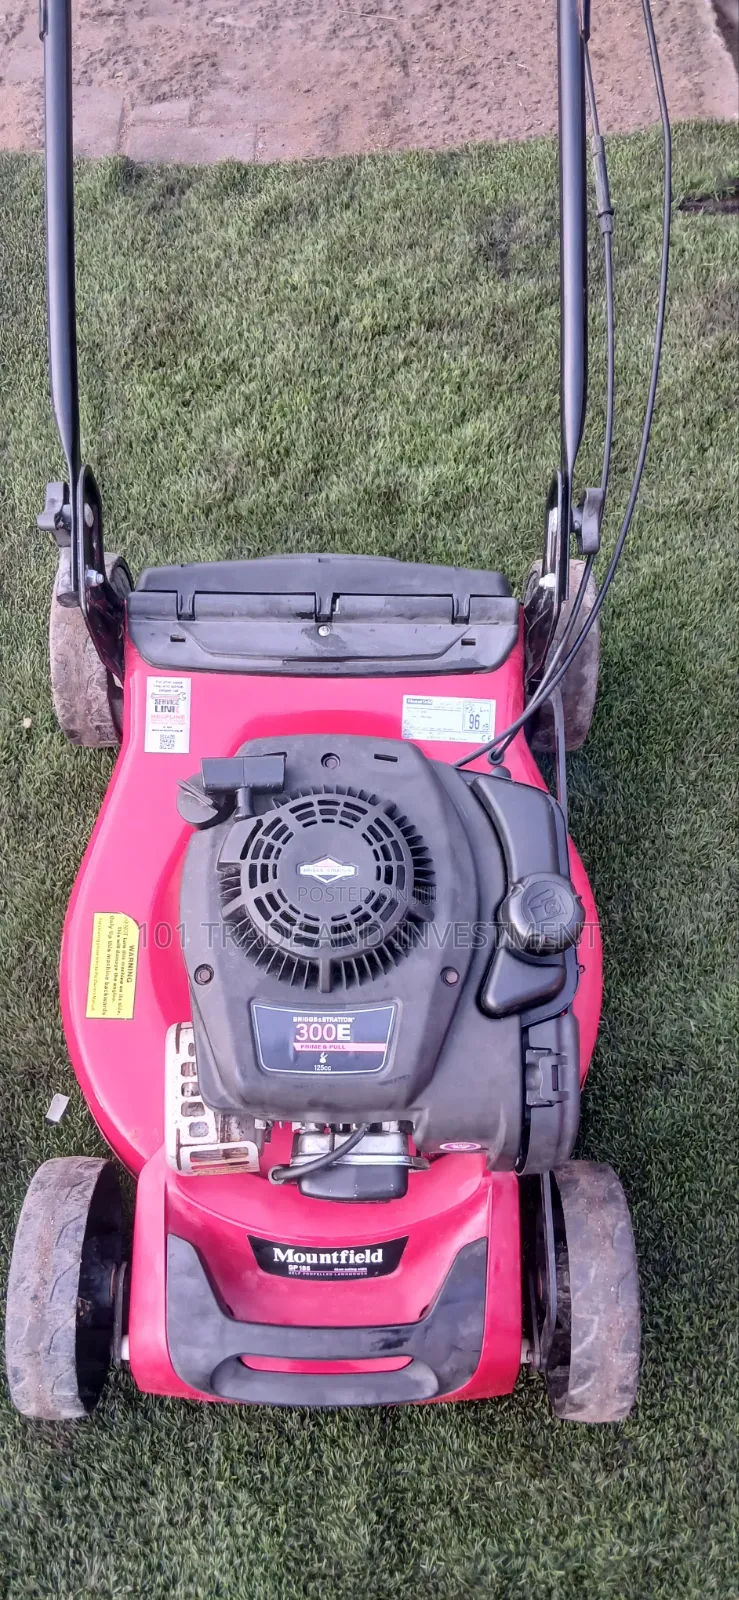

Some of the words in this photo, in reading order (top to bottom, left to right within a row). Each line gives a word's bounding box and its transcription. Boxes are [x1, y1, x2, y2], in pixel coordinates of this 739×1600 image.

[469, 714, 480, 730] 96
[127, 945, 135, 983] WARNING
[102, 982, 110, 1016] backwards
[296, 1023, 350, 1041] 300E
[272, 1248, 384, 1264] Mountfield
